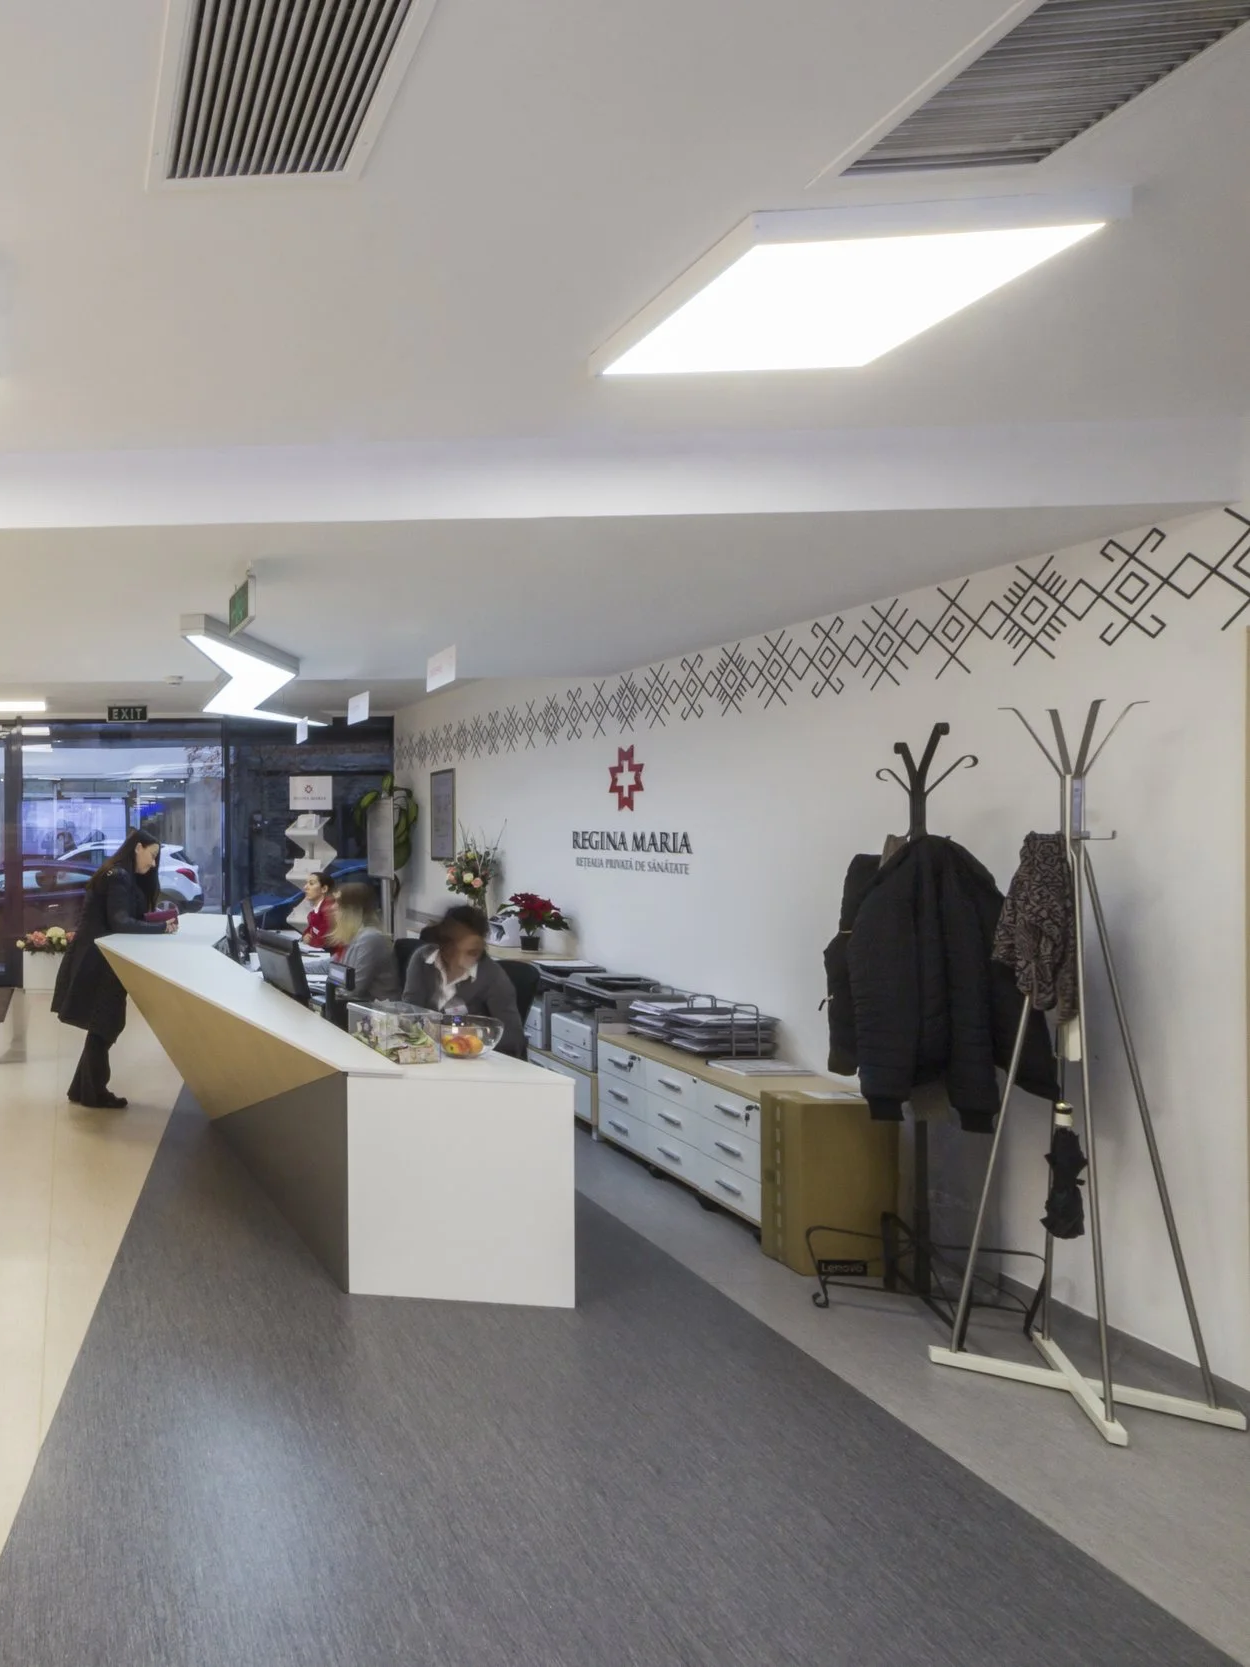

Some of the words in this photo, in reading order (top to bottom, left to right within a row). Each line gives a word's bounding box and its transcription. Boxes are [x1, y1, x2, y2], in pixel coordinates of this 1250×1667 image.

[112, 708, 143, 720] EXIT
[572, 830, 629, 851] REGINA
[631, 831, 693, 854] MARIA
[635, 860, 646, 872] DE
